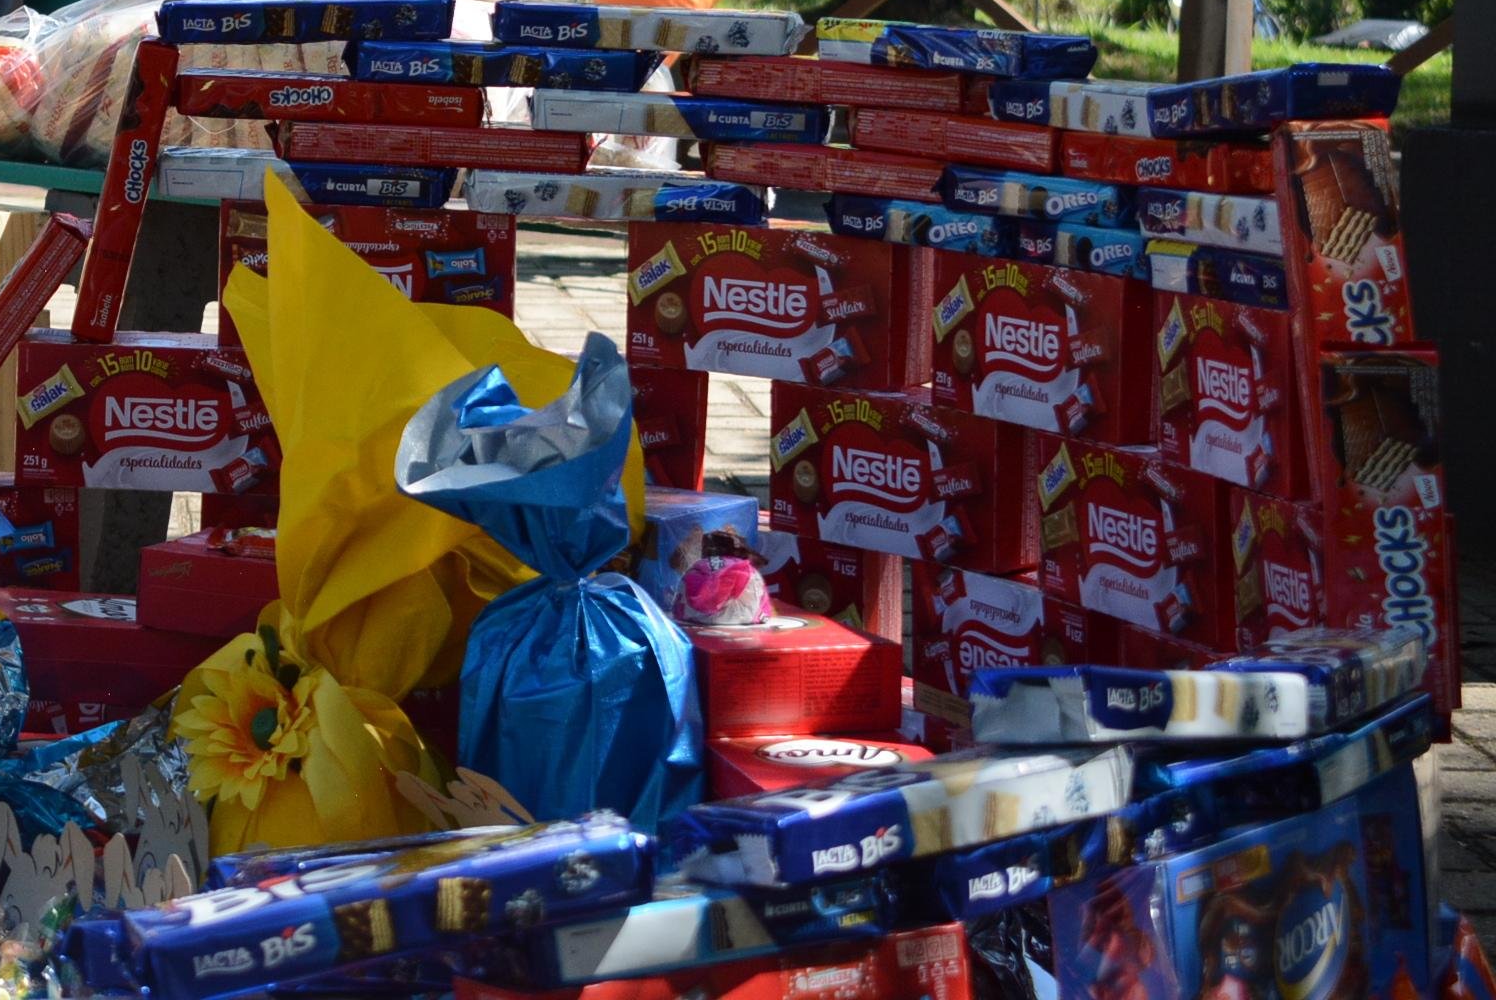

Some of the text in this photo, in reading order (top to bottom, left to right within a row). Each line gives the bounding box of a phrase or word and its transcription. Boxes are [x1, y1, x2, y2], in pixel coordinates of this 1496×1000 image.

[183, 18, 216, 31] LACTA
[520, 25, 553, 39] LACTA
[371, 59, 403, 74] LACTA
[940, 56, 965, 67] CURTA
[269, 86, 334, 106] CHOCKS
[1006, 101, 1025, 117] LACTA
[718, 115, 750, 125] CURTA
[125, 138, 148, 204] CHOCKS
[1135, 156, 1173, 181] CHOCKS
[336, 182, 366, 192] CURTA
[703, 198, 736, 212] LACTA
[1046, 191, 1098, 215] OREO
[843, 214, 864, 229] LACTA
[928, 222, 978, 243] OREO
[697, 229, 748, 256] 15 10
[1090, 243, 1133, 267] OREO
[632, 331, 647, 343] 251
[717, 340, 793, 359] especialidades
[97, 354, 120, 377] 15
[133, 350, 152, 372] 10
[30, 383, 68, 411] Galak
[994, 383, 1050, 404] especialidades
[23, 455, 39, 465] 251
[120, 454, 202, 472] especialidades
[845, 511, 910, 533] especialidades
[1106, 686, 1137, 710] LACTA
[812, 844, 860, 874] LACTA
[968, 871, 1007, 900] LACTA
[1278, 893, 1344, 973] ARCOR
[193, 947, 254, 978] LACTA
